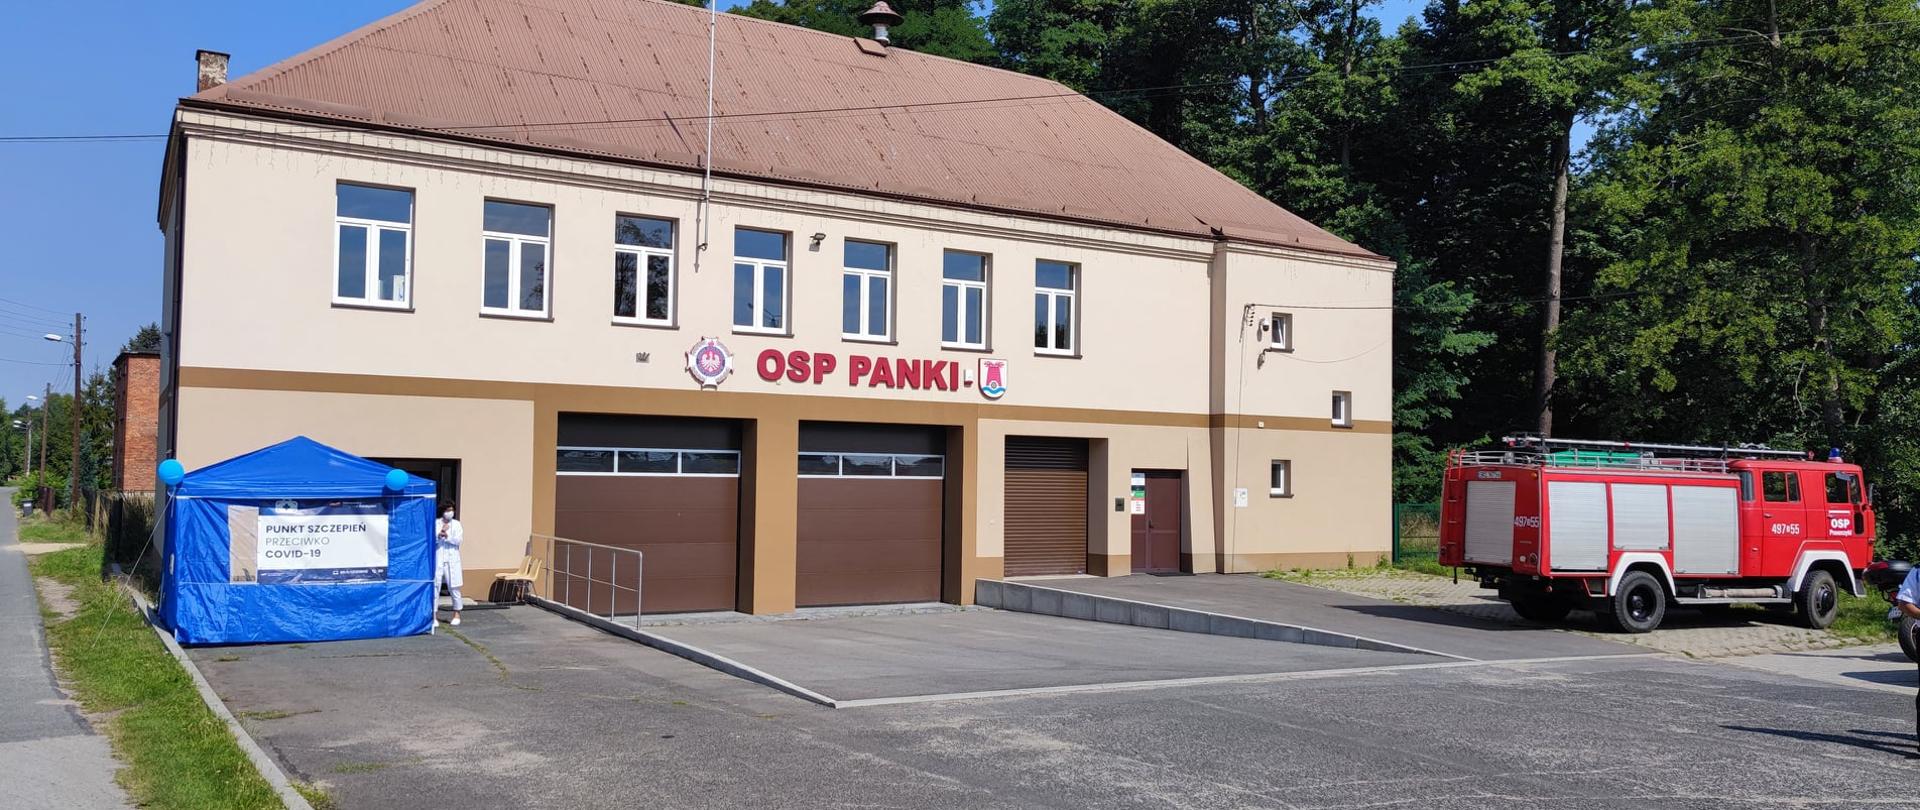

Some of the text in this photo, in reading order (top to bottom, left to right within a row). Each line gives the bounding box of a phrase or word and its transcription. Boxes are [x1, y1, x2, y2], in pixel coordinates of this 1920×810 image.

[756, 349, 960, 391] OSP PANKI
[266, 522, 367, 533] PUNKT SZCZEPIEŃ
[1830, 518, 1850, 529] OSP
[265, 537, 330, 546] PRZECIWKO
[265, 549, 321, 558] COVID-19
